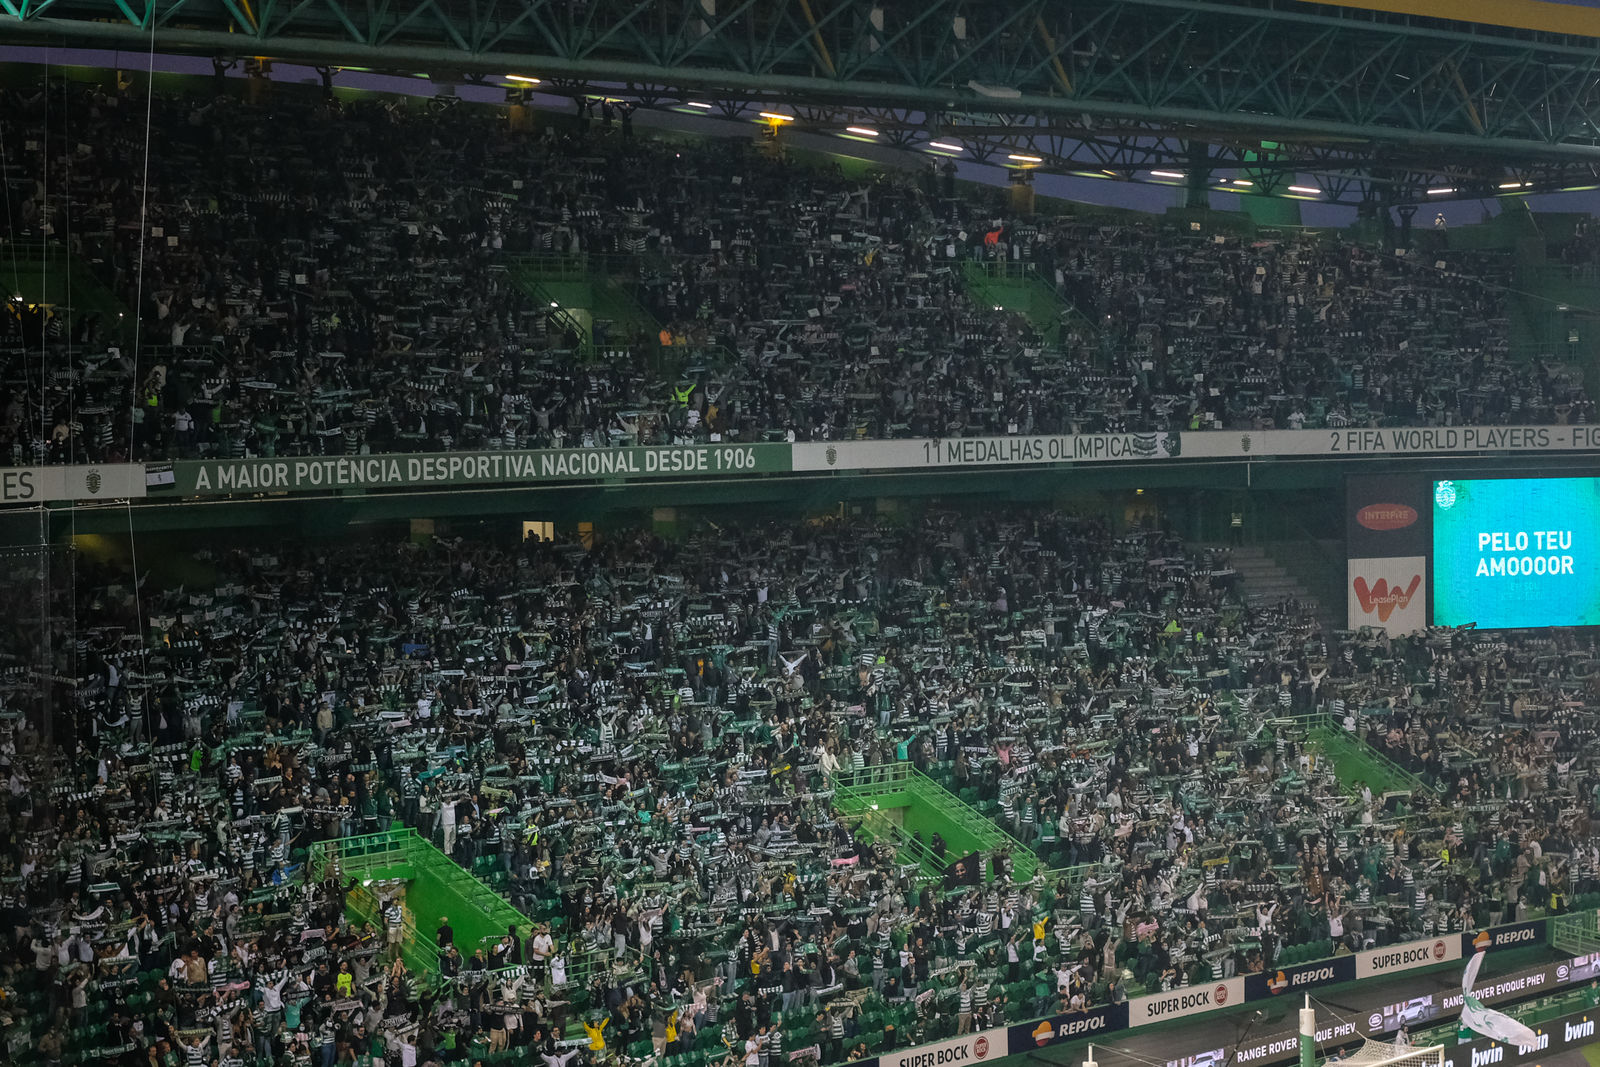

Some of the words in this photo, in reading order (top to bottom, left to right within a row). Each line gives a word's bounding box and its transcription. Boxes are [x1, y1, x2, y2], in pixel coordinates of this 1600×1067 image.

[923, 441, 941, 463] 11
[948, 439, 1043, 463] MEDALHAS
[1048, 435, 1133, 460] OLÍMPICA
[1330, 431, 1340, 451] 2
[1347, 431, 1385, 451] FIFA
[1392, 430, 1457, 450] WORLD
[1464, 428, 1550, 449] PLAYERS
[195, 465, 212, 490] A
[218, 463, 289, 490] MAIOR
[295, 458, 402, 486] POTÊNCIA
[408, 455, 537, 481] DESPORTIVA
[542, 451, 640, 477] NACIONAL
[645, 449, 708, 472] DESDE
[714, 448, 755, 470] 1906
[3, 471, 35, 500] ES
[1478, 531, 1528, 552] PELO
[1533, 531, 1572, 550] TEU
[1475, 555, 1574, 577] AMOOOOR
[1369, 594, 1408, 605] LeasePlan
[1495, 928, 1536, 946] REPSOL
[1372, 952, 1402, 970] SUPER
[1403, 947, 1429, 964] BOCK
[1292, 967, 1334, 986] REPSOL
[1443, 995, 1465, 1009] RANG
[1496, 981, 1525, 996] EVOQUE
[1526, 973, 1546, 988] PHEV
[1147, 996, 1179, 1017] SUPER
[1181, 991, 1210, 1010] BOCK
[1059, 1015, 1106, 1037] REPSOL
[1564, 1016, 1595, 1042] bwin
[1237, 1045, 1267, 1063] RANGE
[1269, 1037, 1298, 1055] ROVER
[1334, 1022, 1356, 1038] PHEV
[1471, 1041, 1504, 1067] bwin
[900, 1052, 935, 1067] SUPER
[937, 1044, 969, 1065] BOCK
